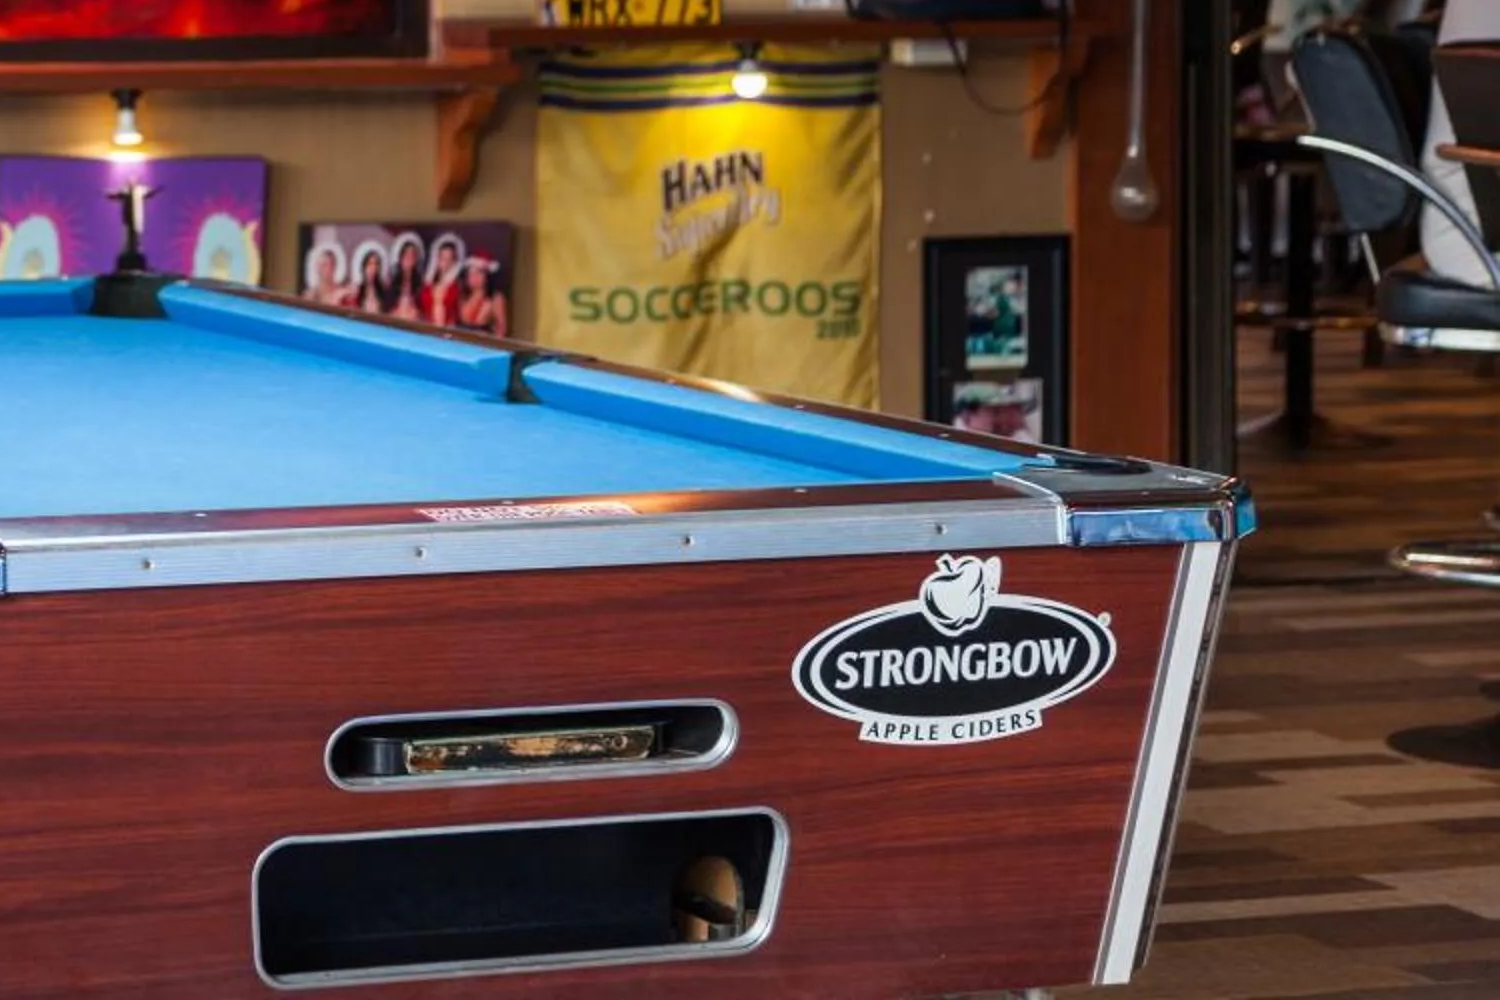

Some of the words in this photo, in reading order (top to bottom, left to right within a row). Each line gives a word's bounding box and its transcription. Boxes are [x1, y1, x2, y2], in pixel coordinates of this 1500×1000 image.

[662, 152, 764, 211] HAHN
[834, 637, 1077, 690] STRONGBOW
[866, 721, 940, 741] APPLE
[951, 710, 1037, 740] CIDERS
